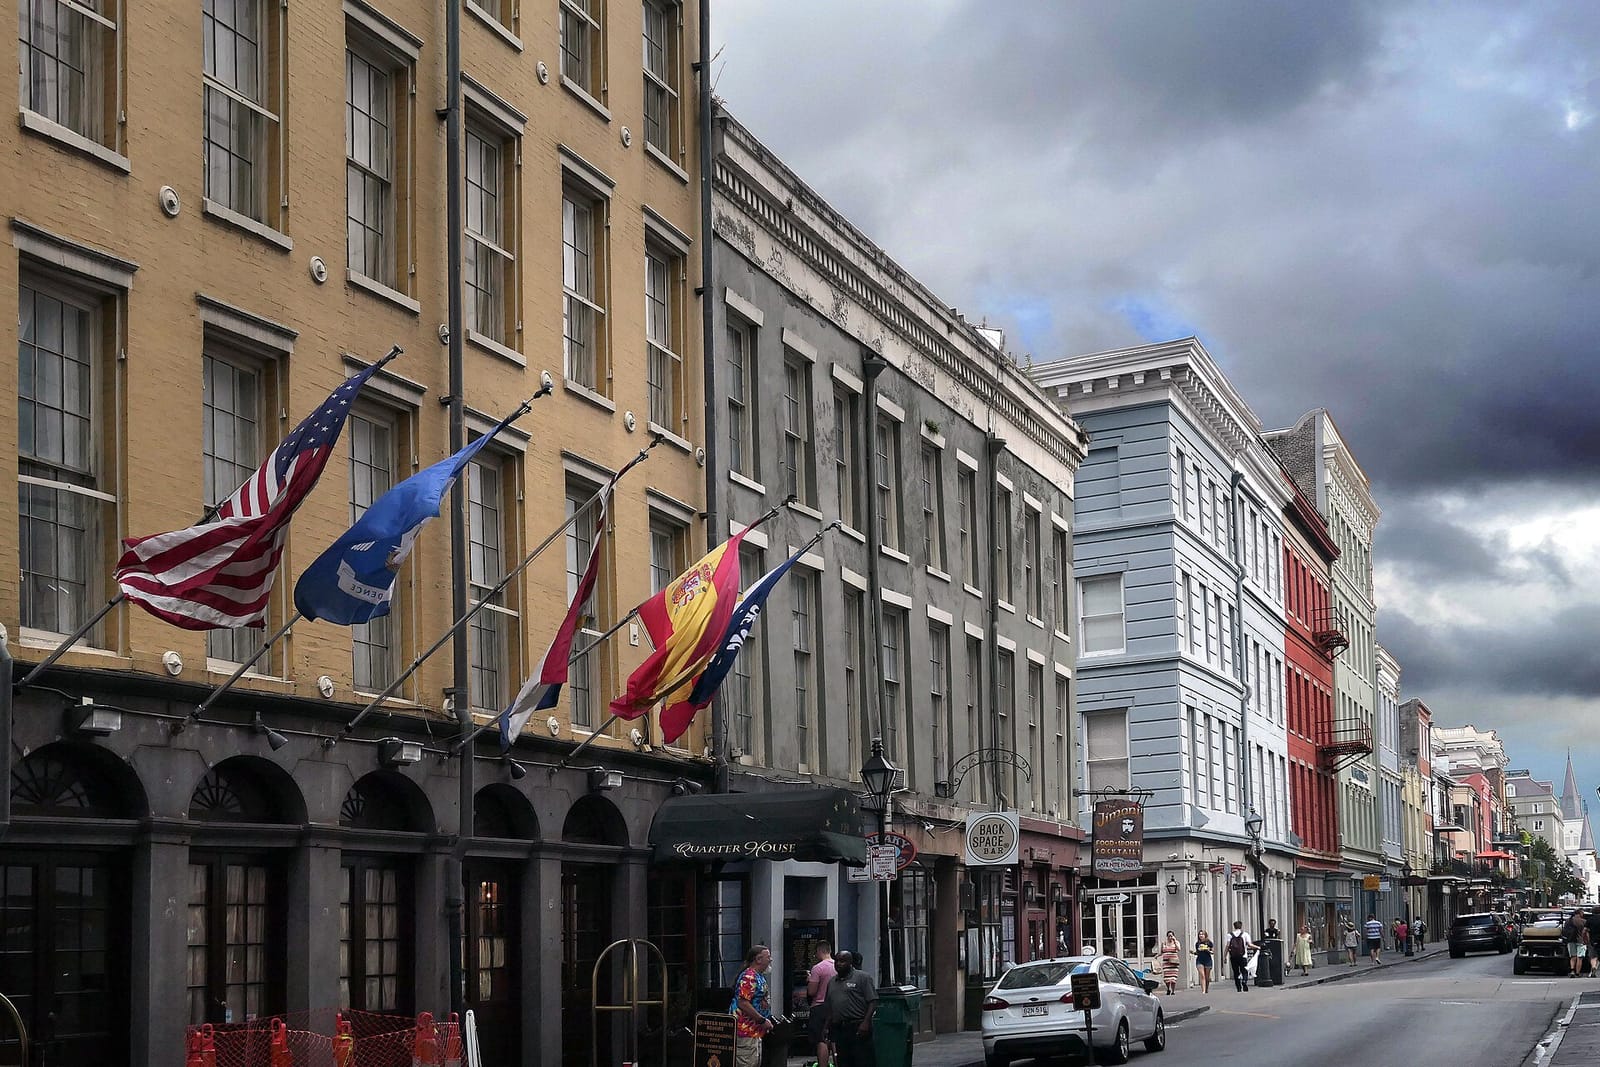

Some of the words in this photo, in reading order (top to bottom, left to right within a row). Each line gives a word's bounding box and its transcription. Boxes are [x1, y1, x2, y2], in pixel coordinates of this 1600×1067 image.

[980, 823, 1005, 835] BACK
[866, 834, 909, 848] NEAKY
[972, 836, 1004, 848] SPACE
[673, 841, 741, 858] QUARTER
[744, 840, 797, 857] HOUSE
